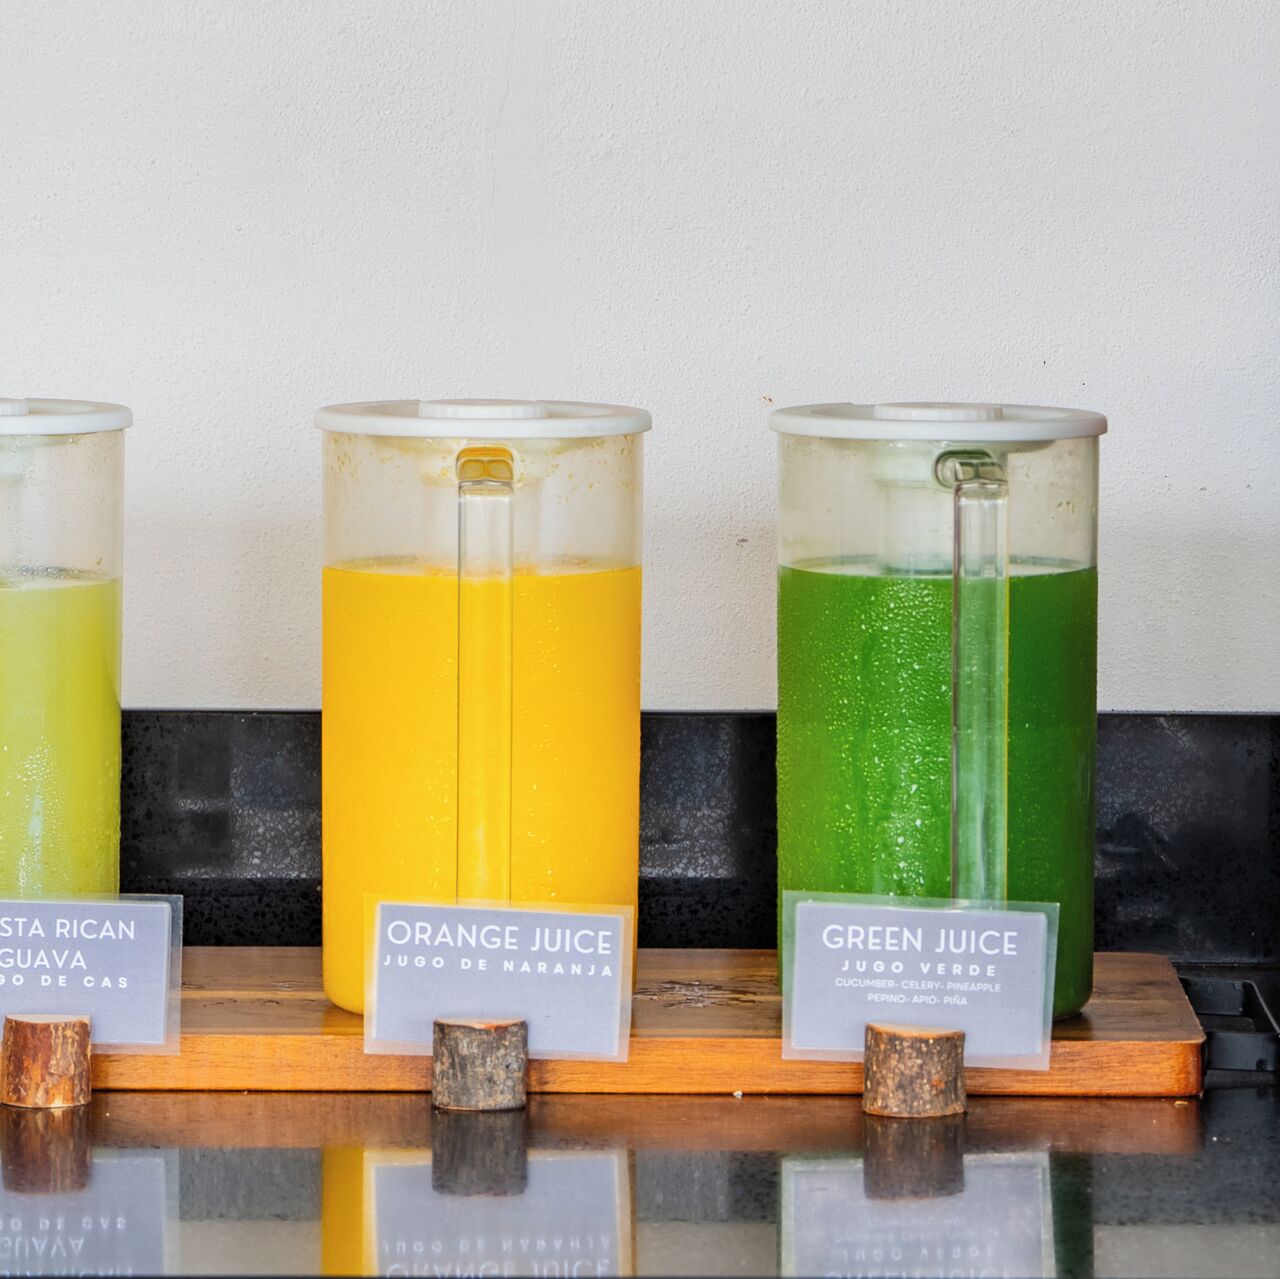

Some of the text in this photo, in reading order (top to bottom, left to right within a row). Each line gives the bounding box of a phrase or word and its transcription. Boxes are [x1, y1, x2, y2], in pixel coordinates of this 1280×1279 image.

[56, 919, 135, 940] RICAN
[387, 920, 612, 954] ORANGE JUICE
[822, 924, 1018, 956] GREEN JUICE
[383, 955, 613, 976] JUGO DE NARANJA
[842, 960, 996, 976] JUGO VERDE
[41, 976, 67, 986] DE
[83, 977, 128, 988] CAS
[947, 982, 1001, 992] PINEAPPLE
[944, 995, 967, 1005] PIÑA
